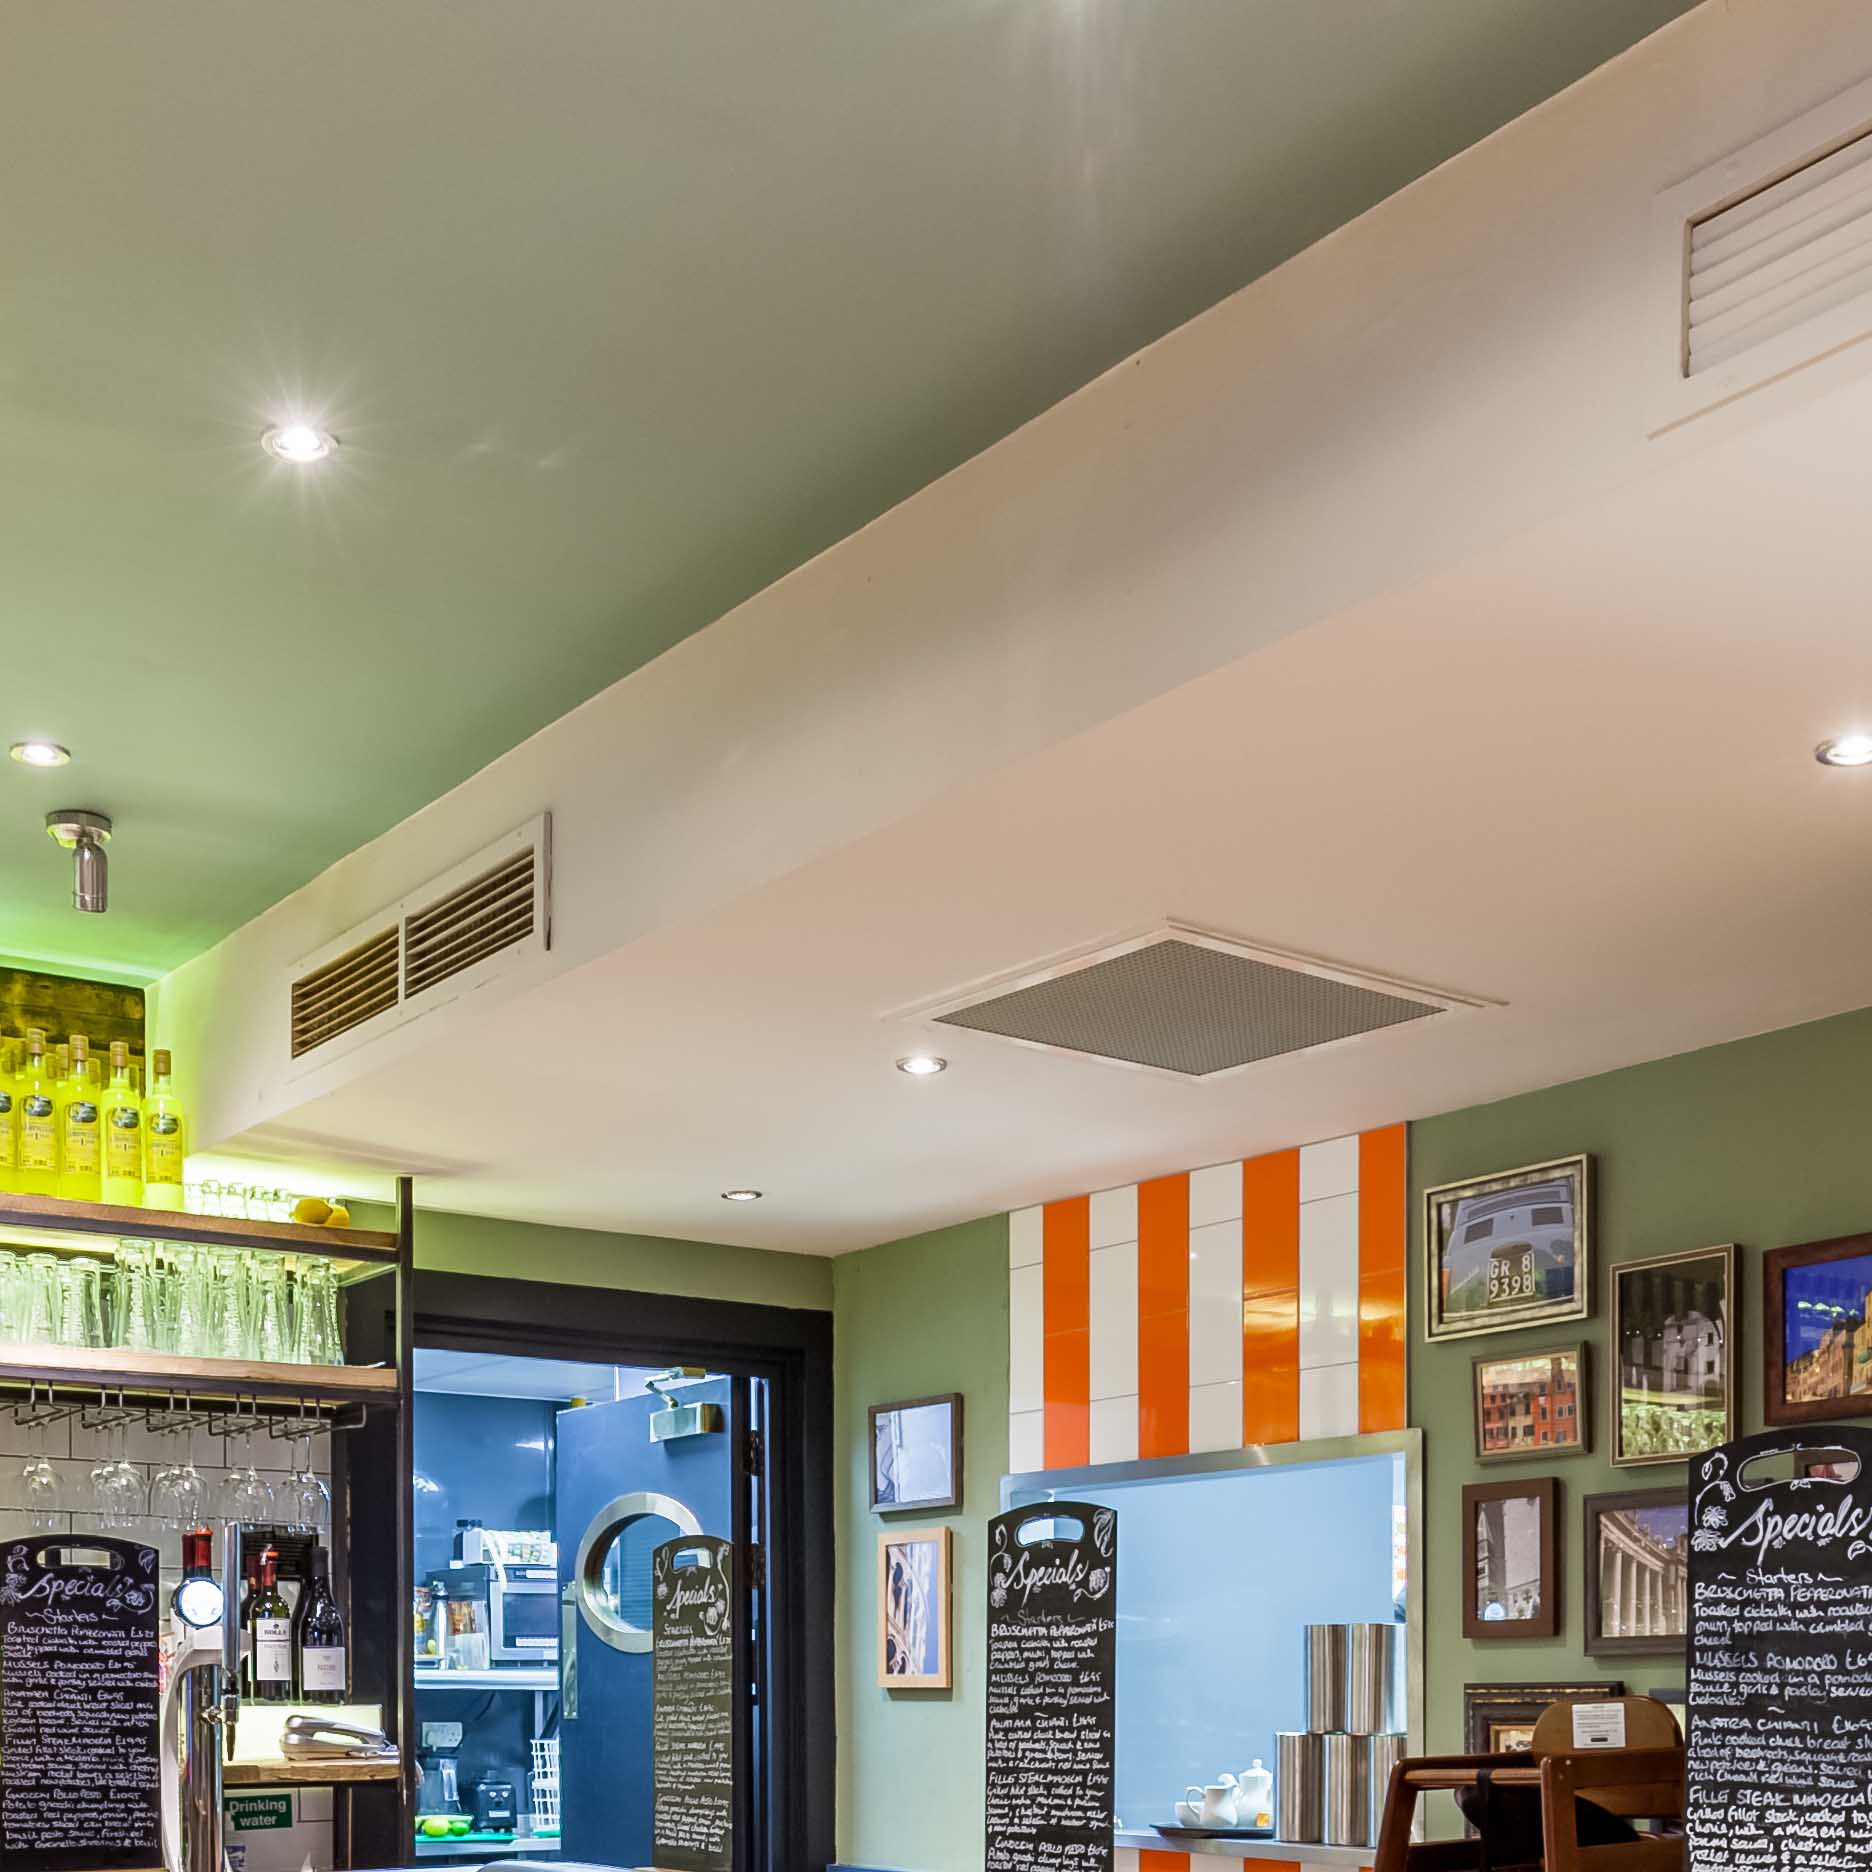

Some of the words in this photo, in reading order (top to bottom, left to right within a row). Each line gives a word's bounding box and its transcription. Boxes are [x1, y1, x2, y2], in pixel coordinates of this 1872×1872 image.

[1490, 1260, 1511, 1279] GR
[1521, 1254, 1532, 1273] 8
[1490, 1273, 1533, 1299] 9398
[1721, 1496, 1872, 1567] Specials
[21, 1572, 132, 1605] Specials
[1005, 1549, 1089, 1606] Specials
[1746, 1568, 1813, 1585] Starters
[667, 1576, 721, 1618] Specials
[229, 1799, 287, 1814] Drinking
[239, 1814, 278, 1828] water
